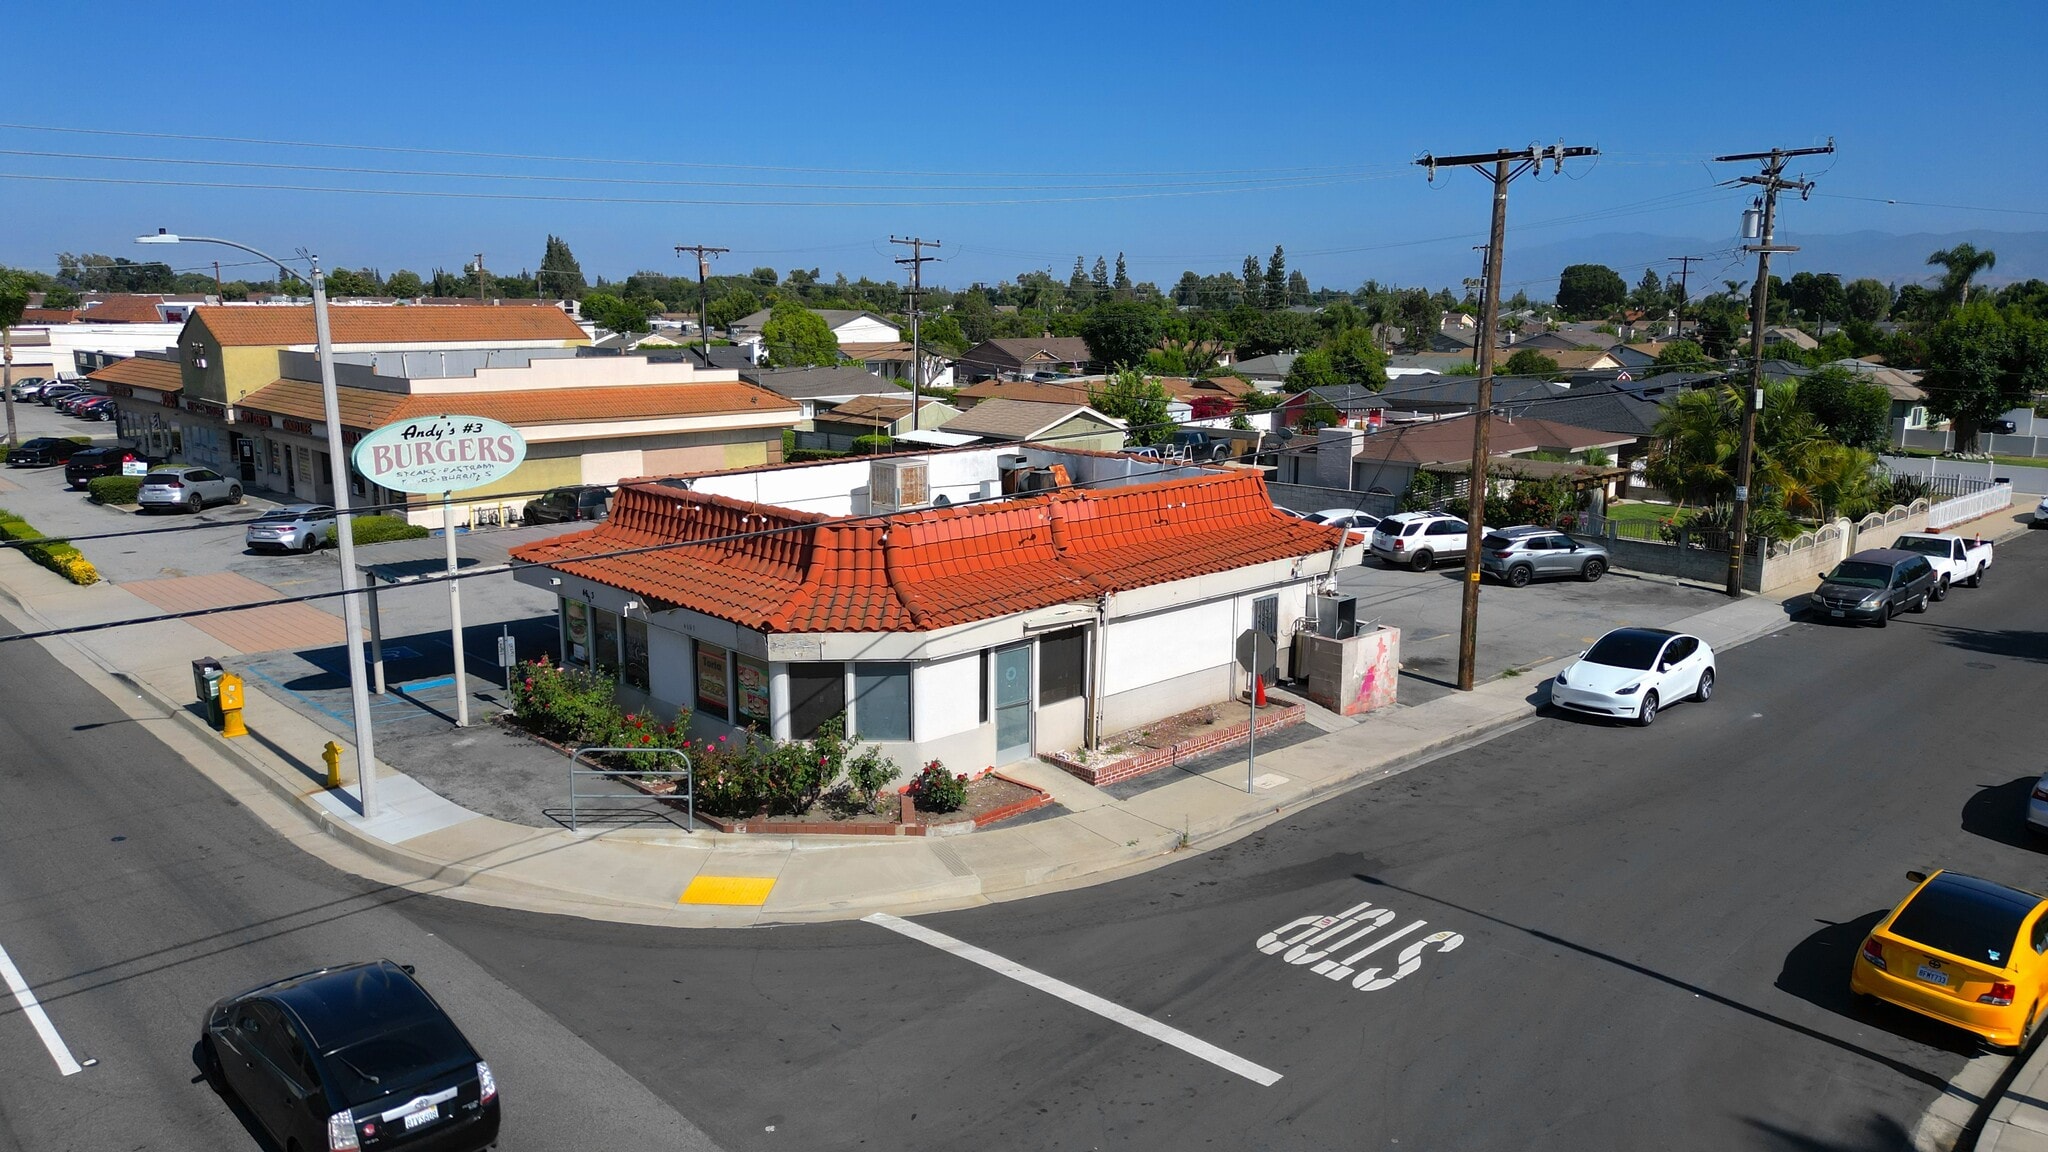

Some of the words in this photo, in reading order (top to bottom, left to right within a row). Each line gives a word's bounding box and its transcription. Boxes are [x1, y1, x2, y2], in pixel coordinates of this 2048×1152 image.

[401, 422, 456, 441] Andy's
[462, 423, 484, 434] #3
[372, 435, 515, 476] BURGERS
[1256, 901, 1464, 991] STOP
